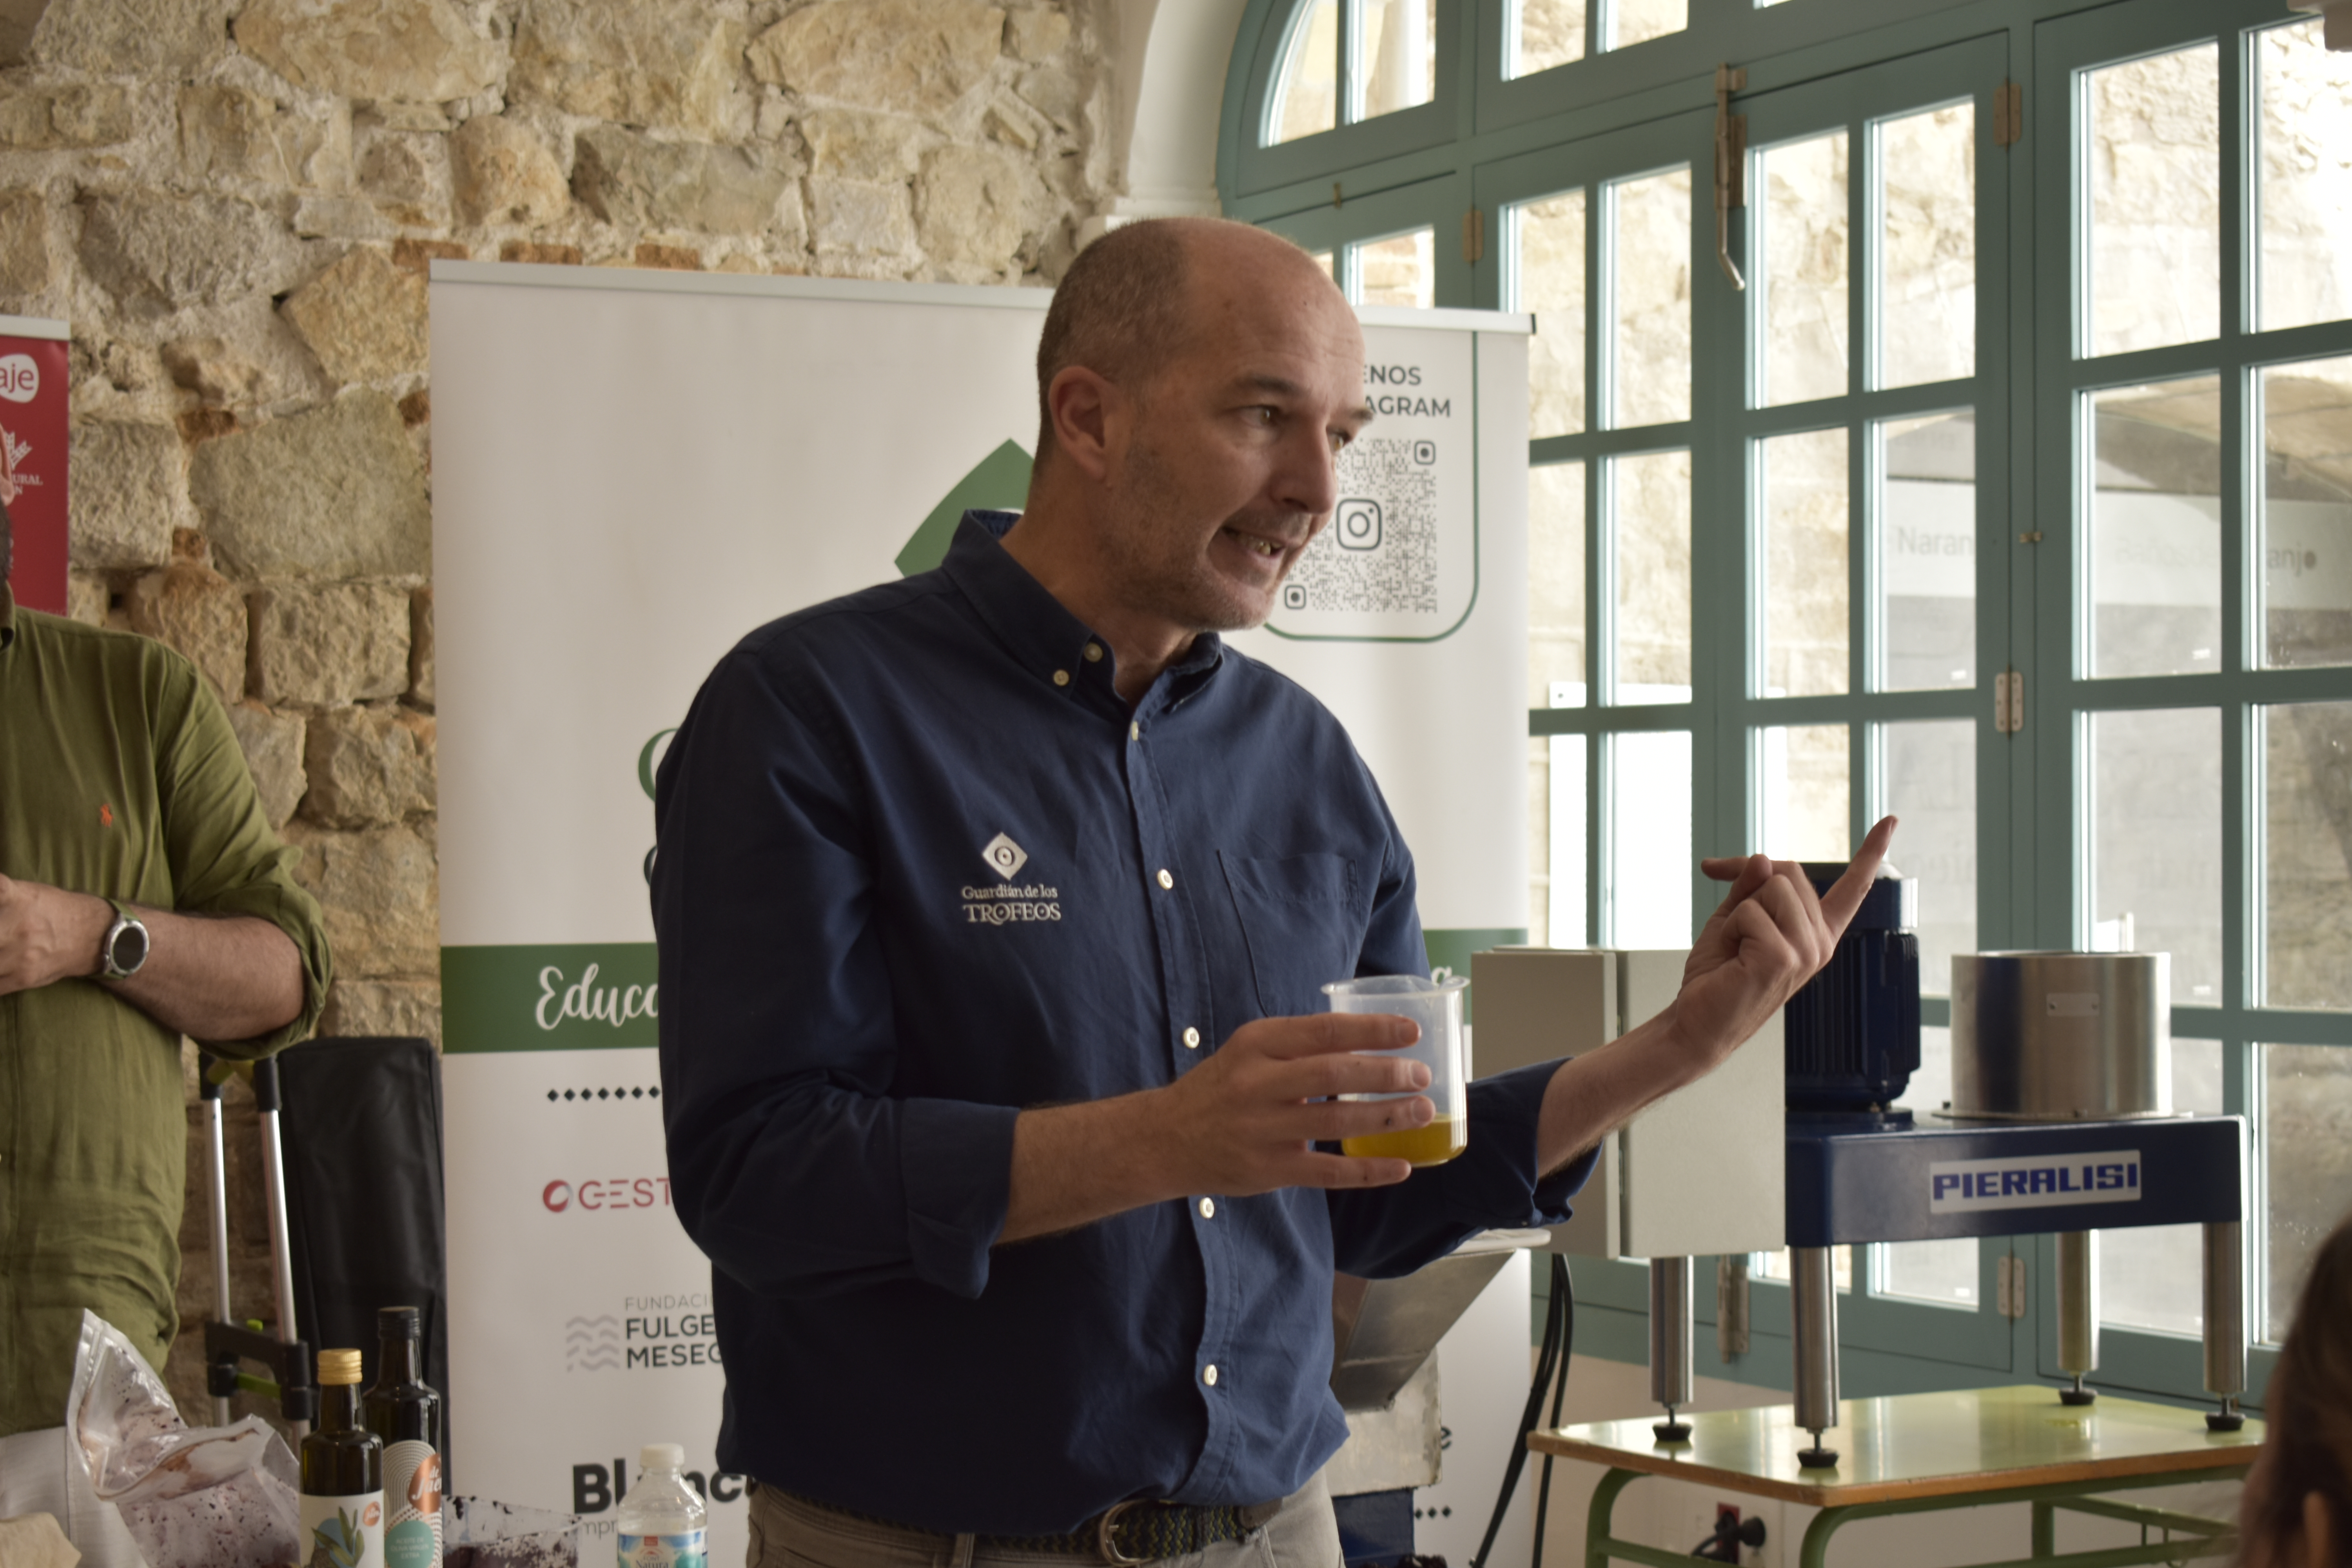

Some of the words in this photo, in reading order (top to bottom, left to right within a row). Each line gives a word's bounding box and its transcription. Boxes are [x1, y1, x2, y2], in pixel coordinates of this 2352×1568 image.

[1024, 884, 1039, 898] de
[1039, 884, 1058, 898] los
[962, 902, 1061, 926] TROFEOS
[1933, 1163, 2138, 1200] PIERALISI
[626, 1315, 715, 1339] FULGE
[573, 1458, 742, 1514] Blnc
